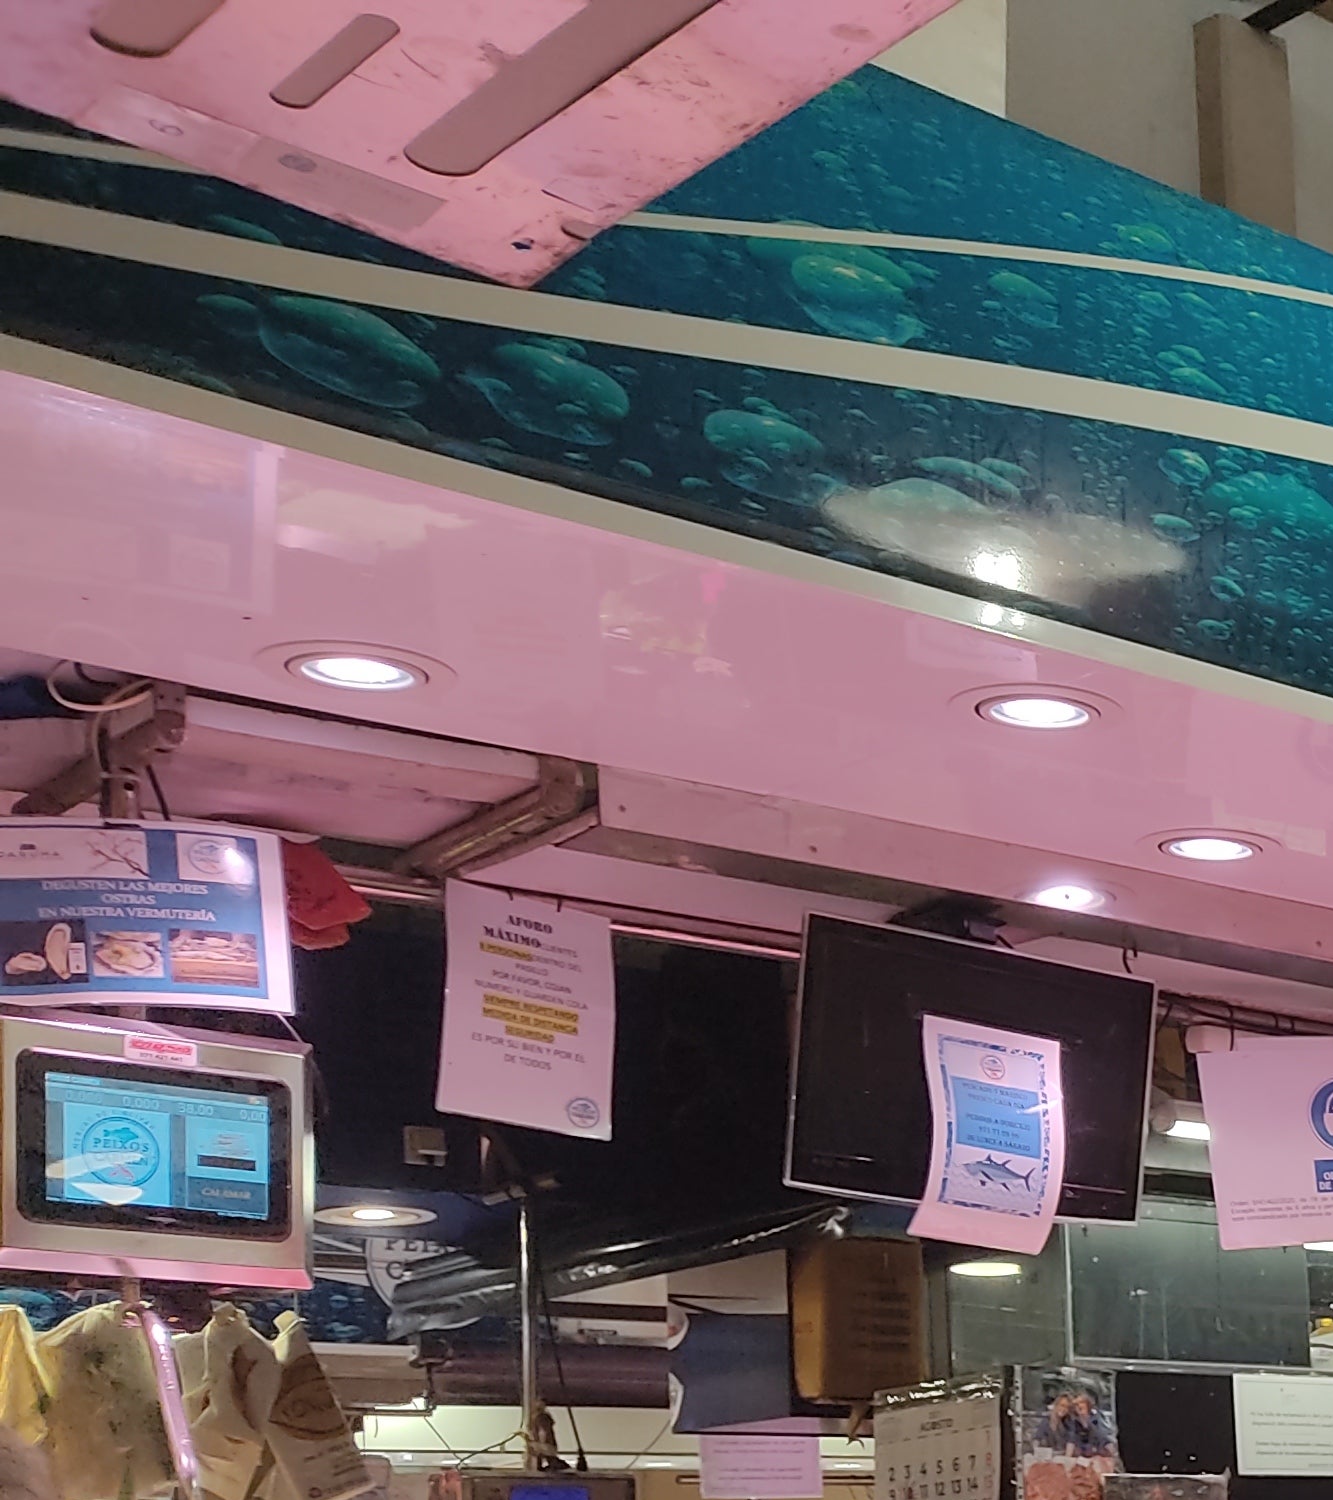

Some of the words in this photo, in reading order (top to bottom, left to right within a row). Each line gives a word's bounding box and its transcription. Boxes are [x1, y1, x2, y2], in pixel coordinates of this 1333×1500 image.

[41, 880, 117, 893] DEGUSTEN
[119, 880, 146, 893] LAS
[148, 882, 209, 895] MEJORES
[37, 907, 57, 918] EN
[60, 907, 124, 919] NUESTRA
[126, 907, 216, 922] VERMUTERÍA
[504, 914, 553, 935] AFORO
[92, 1137, 150, 1152] PEIXOS
[1319, 1181, 1332, 1192] DE
[888, 1467, 895, 1482] 2
[904, 1465, 911, 1479] 3
[920, 1463, 927, 1475] 4
[936, 1460, 943, 1474] 5
[952, 1457, 960, 1471] 6
[968, 1455, 976, 1470] 7
[935, 1482, 945, 1497] 12
[951, 1480, 962, 1494] 13
[968, 1477, 979, 1492] 14
